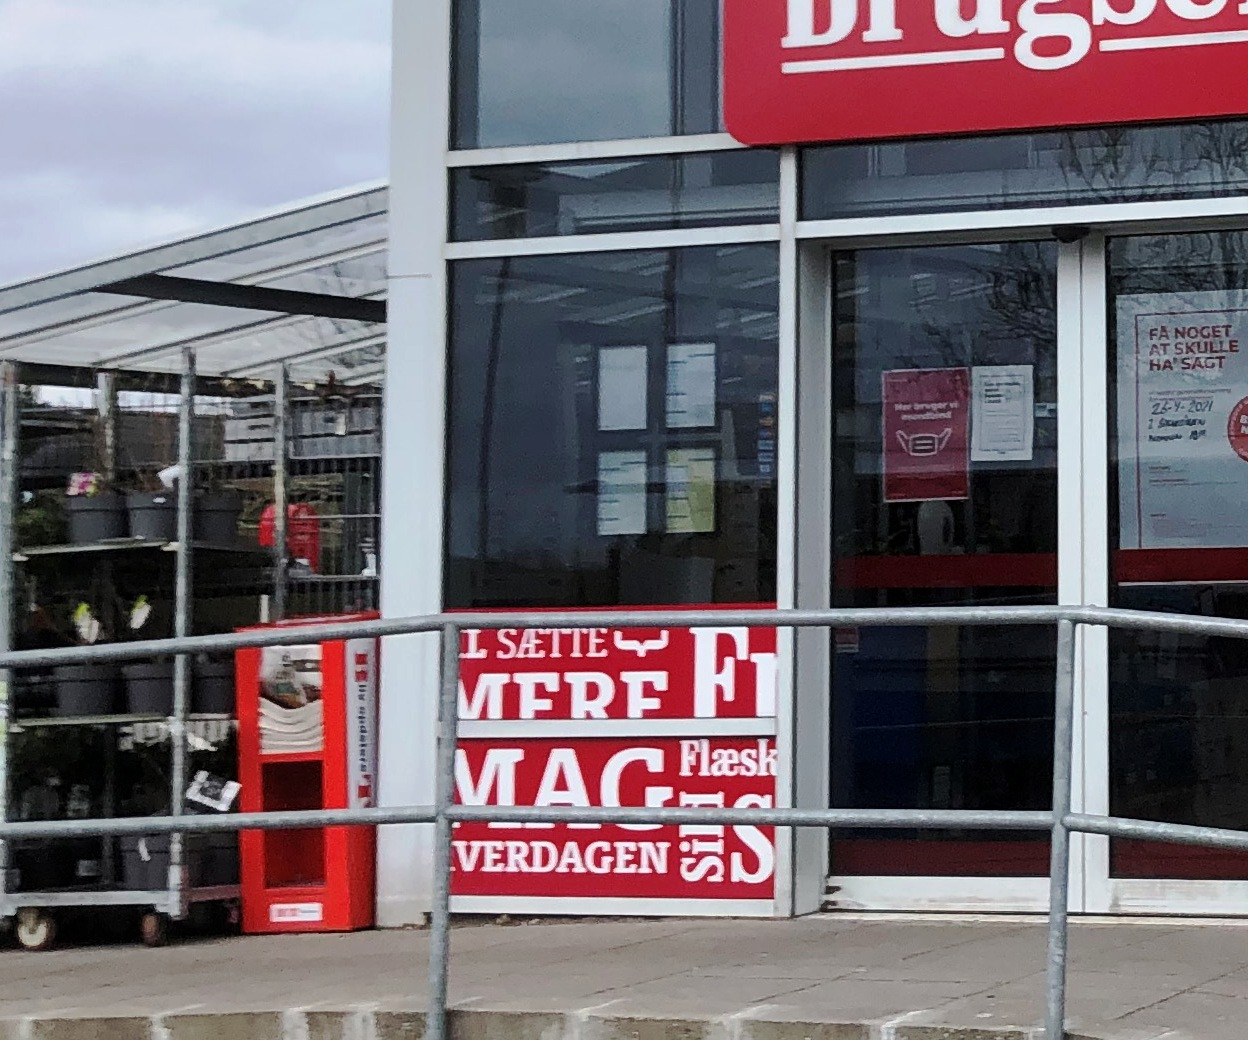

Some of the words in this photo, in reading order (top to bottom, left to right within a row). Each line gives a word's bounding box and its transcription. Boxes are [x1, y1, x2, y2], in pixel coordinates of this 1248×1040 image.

[1149, 342, 1171, 356] AT
[1174, 340, 1240, 355] SKULLE
[1174, 324, 1233, 339] NOGET
[1180, 356, 1226, 370] SAGT
[496, 627, 609, 659] SÆTTE
[457, 671, 669, 718] MERE
[679, 738, 778, 777] Flæsk
[454, 746, 674, 832] MAG
[451, 840, 672, 875] VERDAGEN
